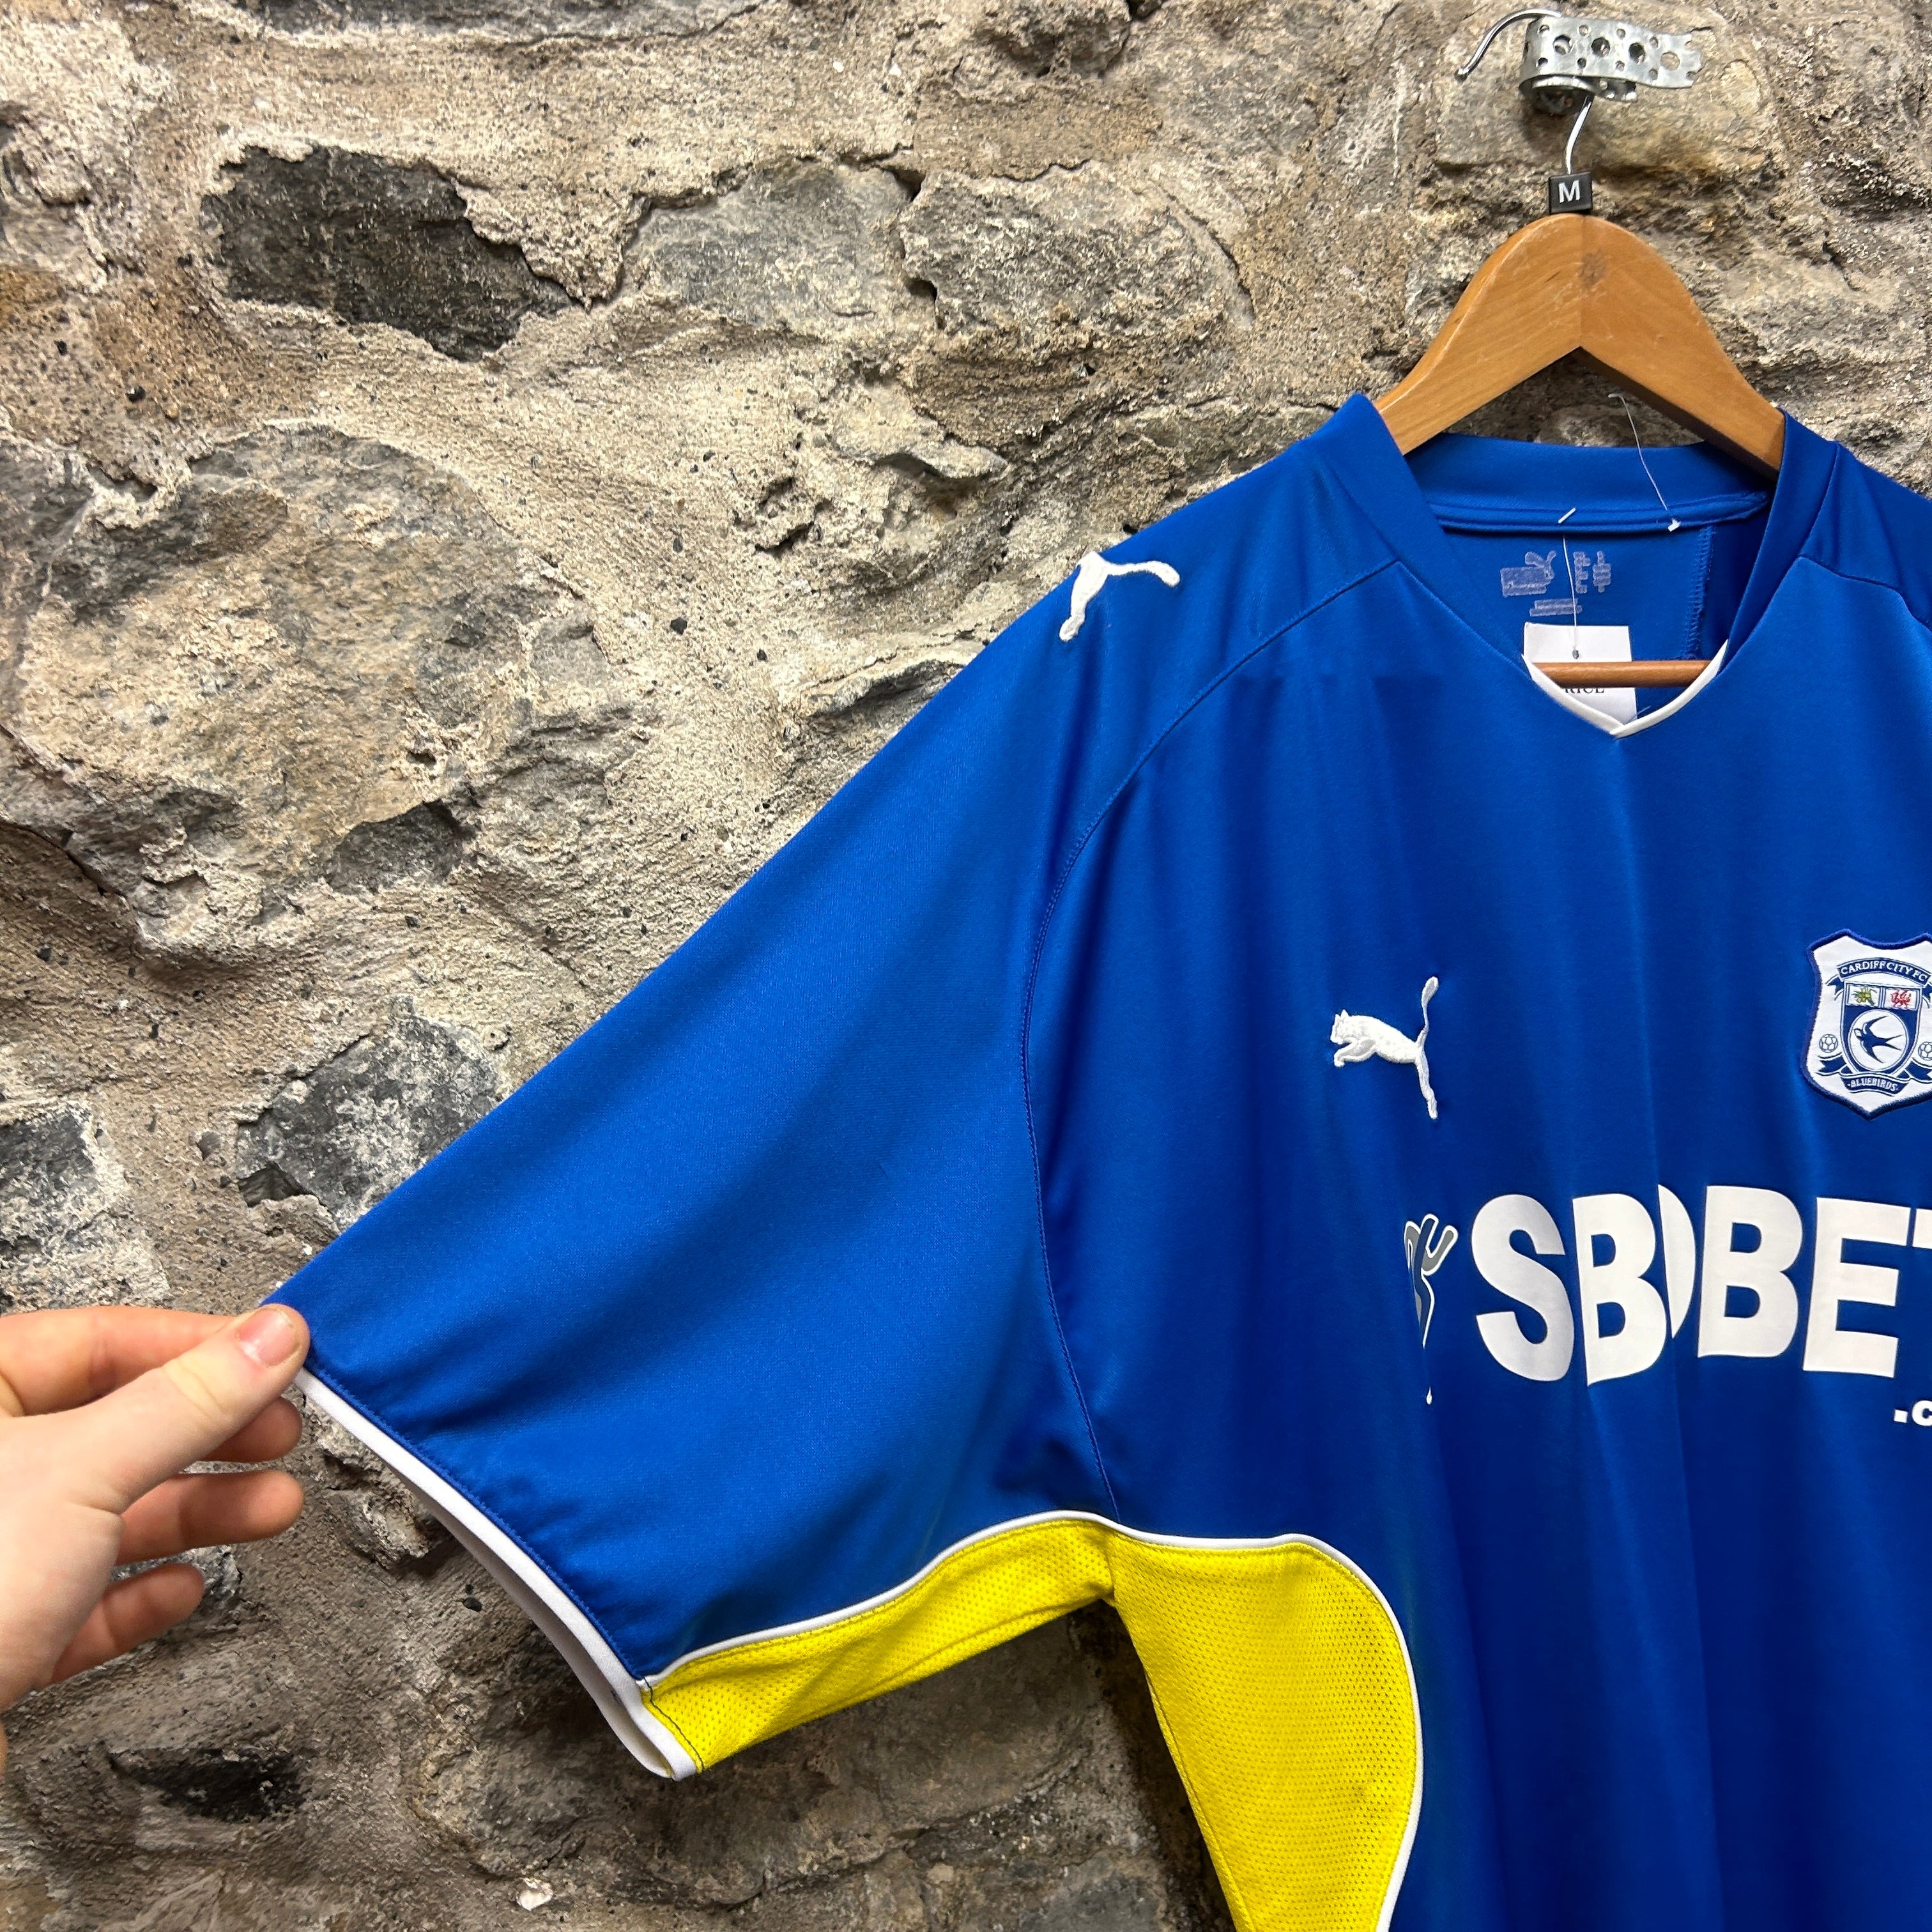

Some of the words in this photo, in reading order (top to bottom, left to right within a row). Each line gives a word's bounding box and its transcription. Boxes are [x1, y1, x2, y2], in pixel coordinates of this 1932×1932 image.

[1558, 180, 1581, 203] M
[1841, 960, 1887, 975] CARDIFF
[1886, 962, 1913, 975] CITY
[1912, 969, 1928, 981] FC
[1850, 1078, 1897, 1091] BLUEBIRDS
